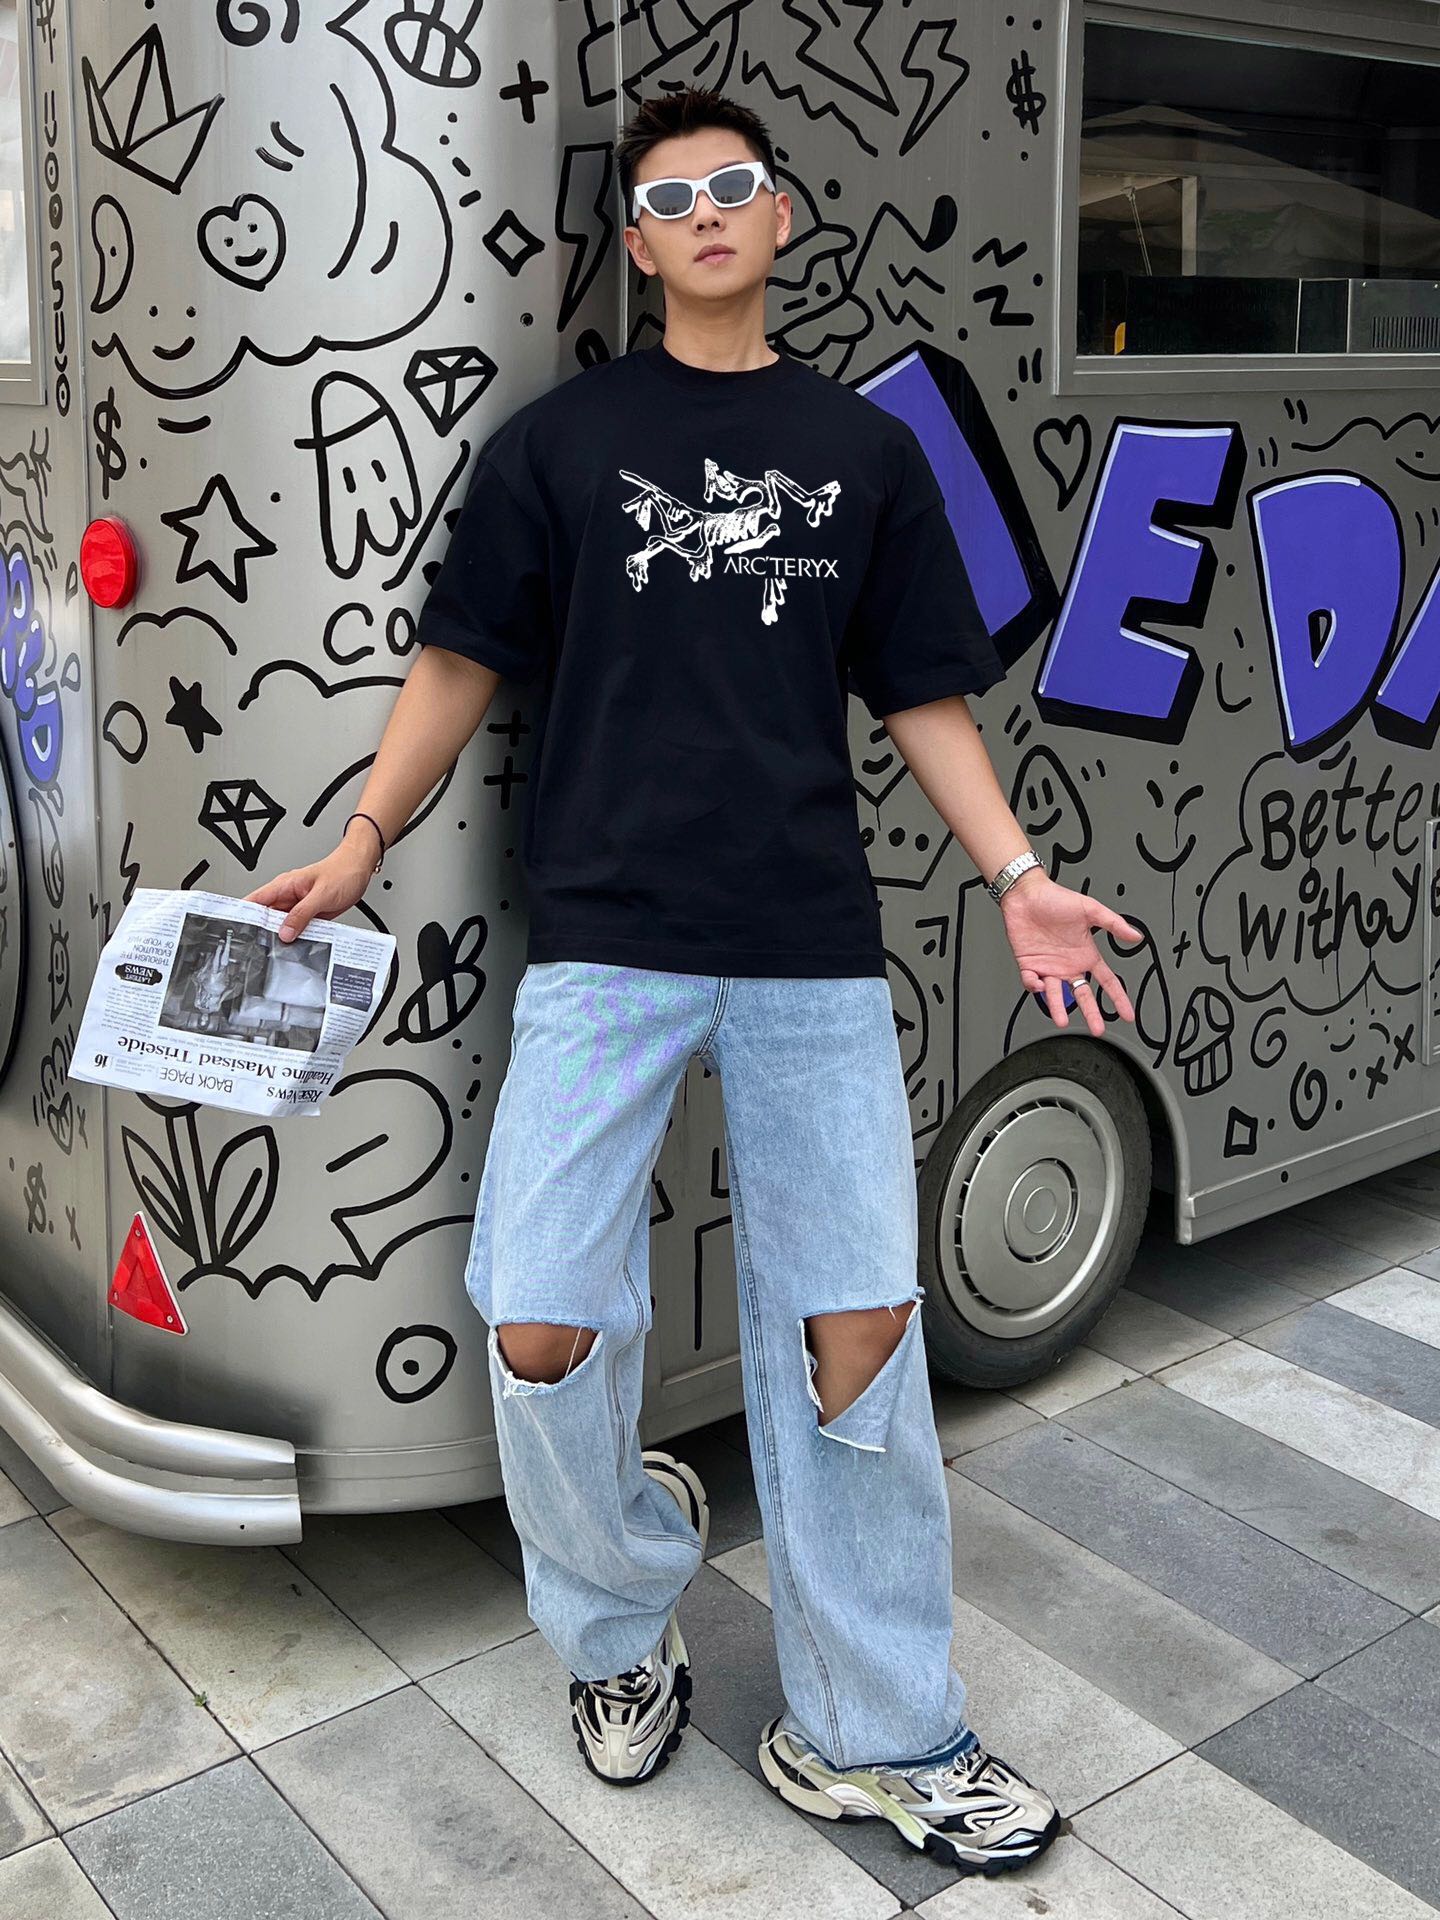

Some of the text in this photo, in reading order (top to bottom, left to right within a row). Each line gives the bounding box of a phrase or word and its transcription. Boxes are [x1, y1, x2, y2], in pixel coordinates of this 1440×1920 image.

[723, 556, 839, 578] ARC'TERYX
[124, 965, 154, 978] NEWS
[94, 1054, 109, 1069] 16
[160, 1067, 195, 1085] PAGE
[198, 1074, 233, 1093] BACK
